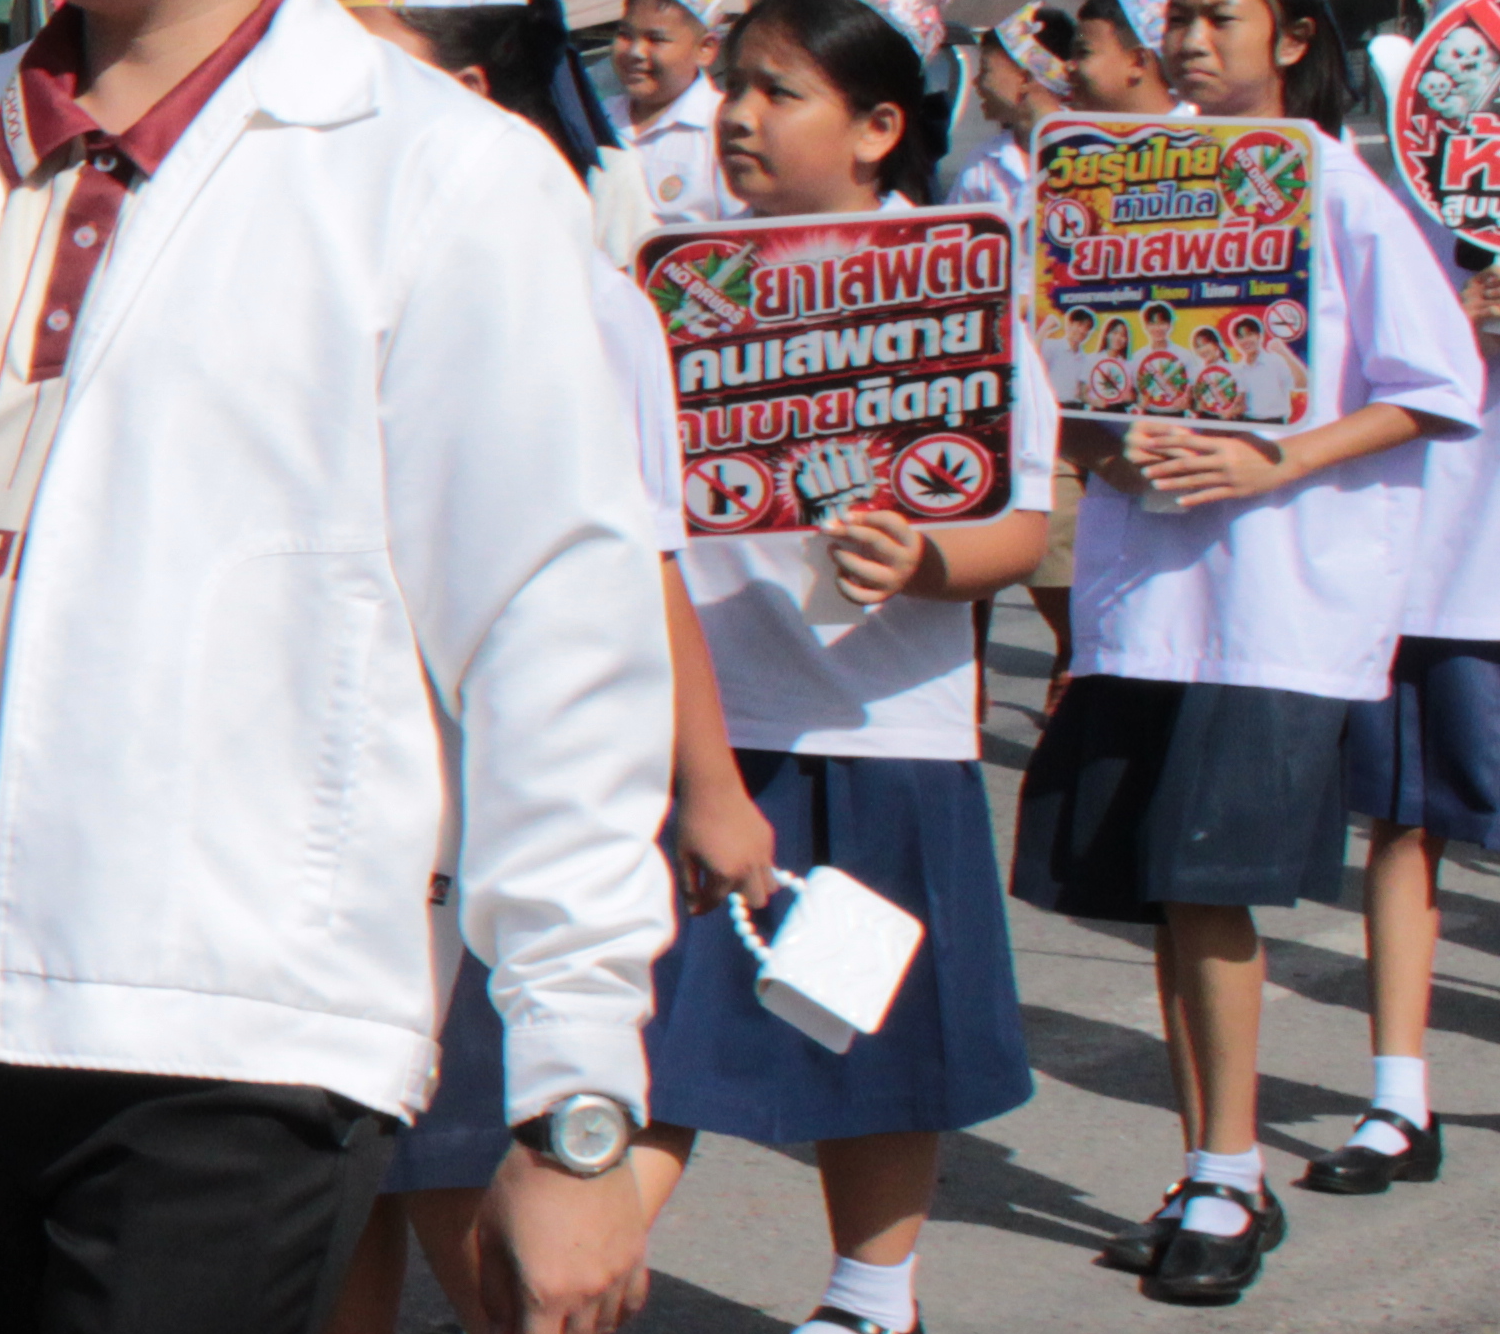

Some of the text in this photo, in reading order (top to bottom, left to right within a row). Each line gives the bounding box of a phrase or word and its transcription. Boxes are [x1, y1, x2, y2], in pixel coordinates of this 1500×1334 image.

[1046, 134, 1221, 194] วัยรุ่นไทย
[1233, 147, 1253, 169] NO
[1112, 181, 1218, 223] ห่างไกล
[752, 227, 1006, 320] ยาเสพติด
[1069, 217, 1294, 279] ยาเสพติด
[663, 261, 746, 326] NO DRUGS
[678, 309, 985, 394] คนเสพตาย
